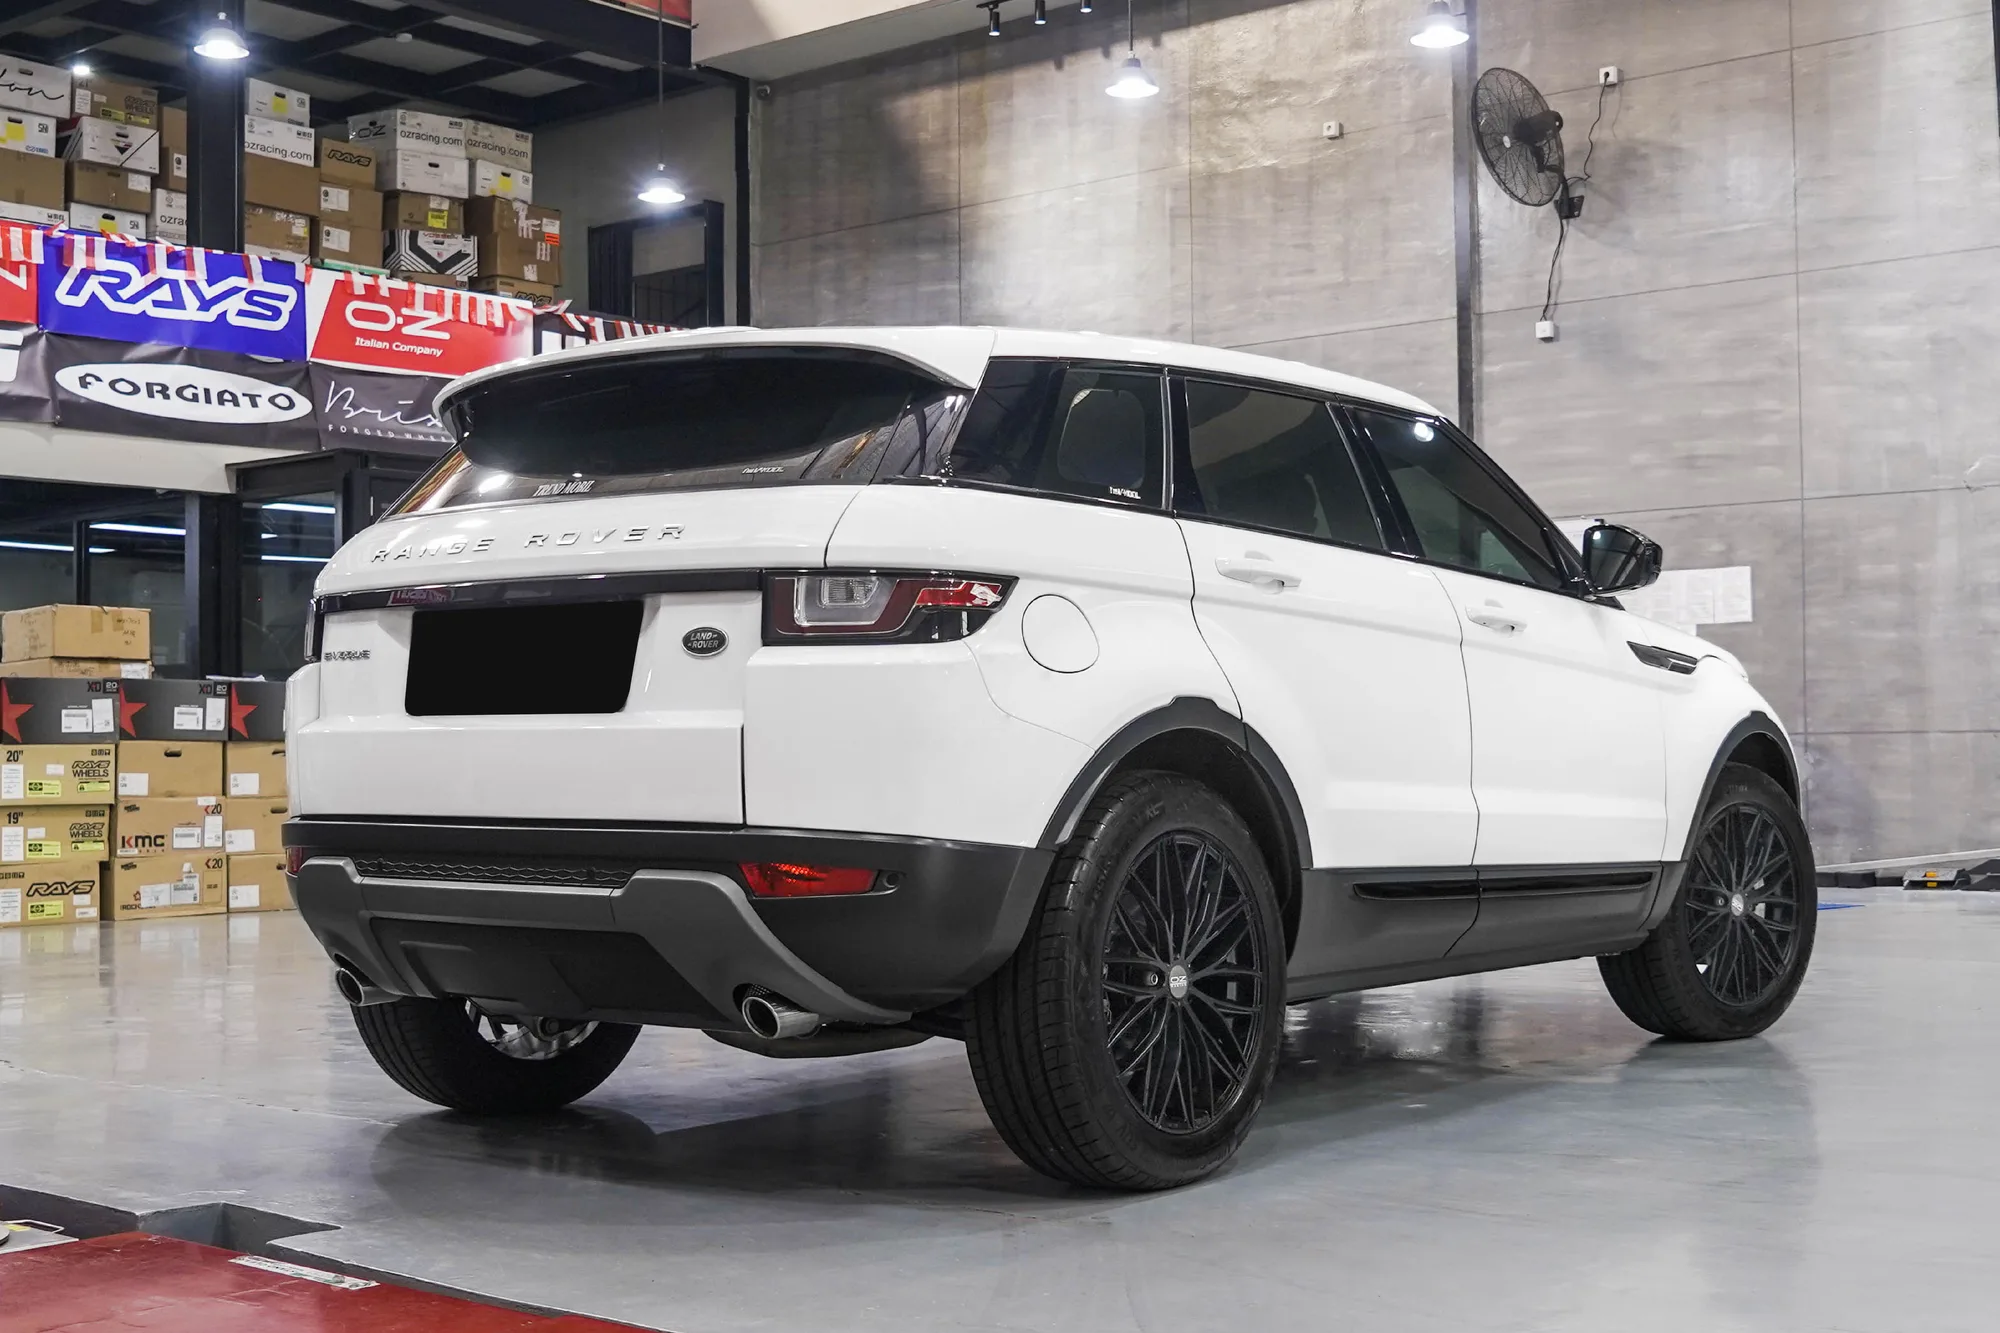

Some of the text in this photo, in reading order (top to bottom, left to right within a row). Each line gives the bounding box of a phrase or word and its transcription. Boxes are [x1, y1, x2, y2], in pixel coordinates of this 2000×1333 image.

[400, 130, 463, 146] ozracing.com
[467, 138, 528, 160] ozracing.com
[328, 149, 372, 167] RAYS
[55, 257, 298, 331] RAYS
[355, 336, 443, 357] Italian Company
[79, 372, 296, 411] FORGIATO
[328, 423, 395, 438] FORGED
[532, 483, 565, 498] TREND
[371, 523, 686, 563] RANGE ROVER
[690, 632, 713, 641] LAND
[692, 640, 719, 648] ROVER
[106, 681, 118, 689] 20
[72, 760, 111, 769] RAYS
[72, 769, 109, 777] WHEELS
[69, 823, 105, 831] RAYS
[26, 880, 95, 897] RAYS
